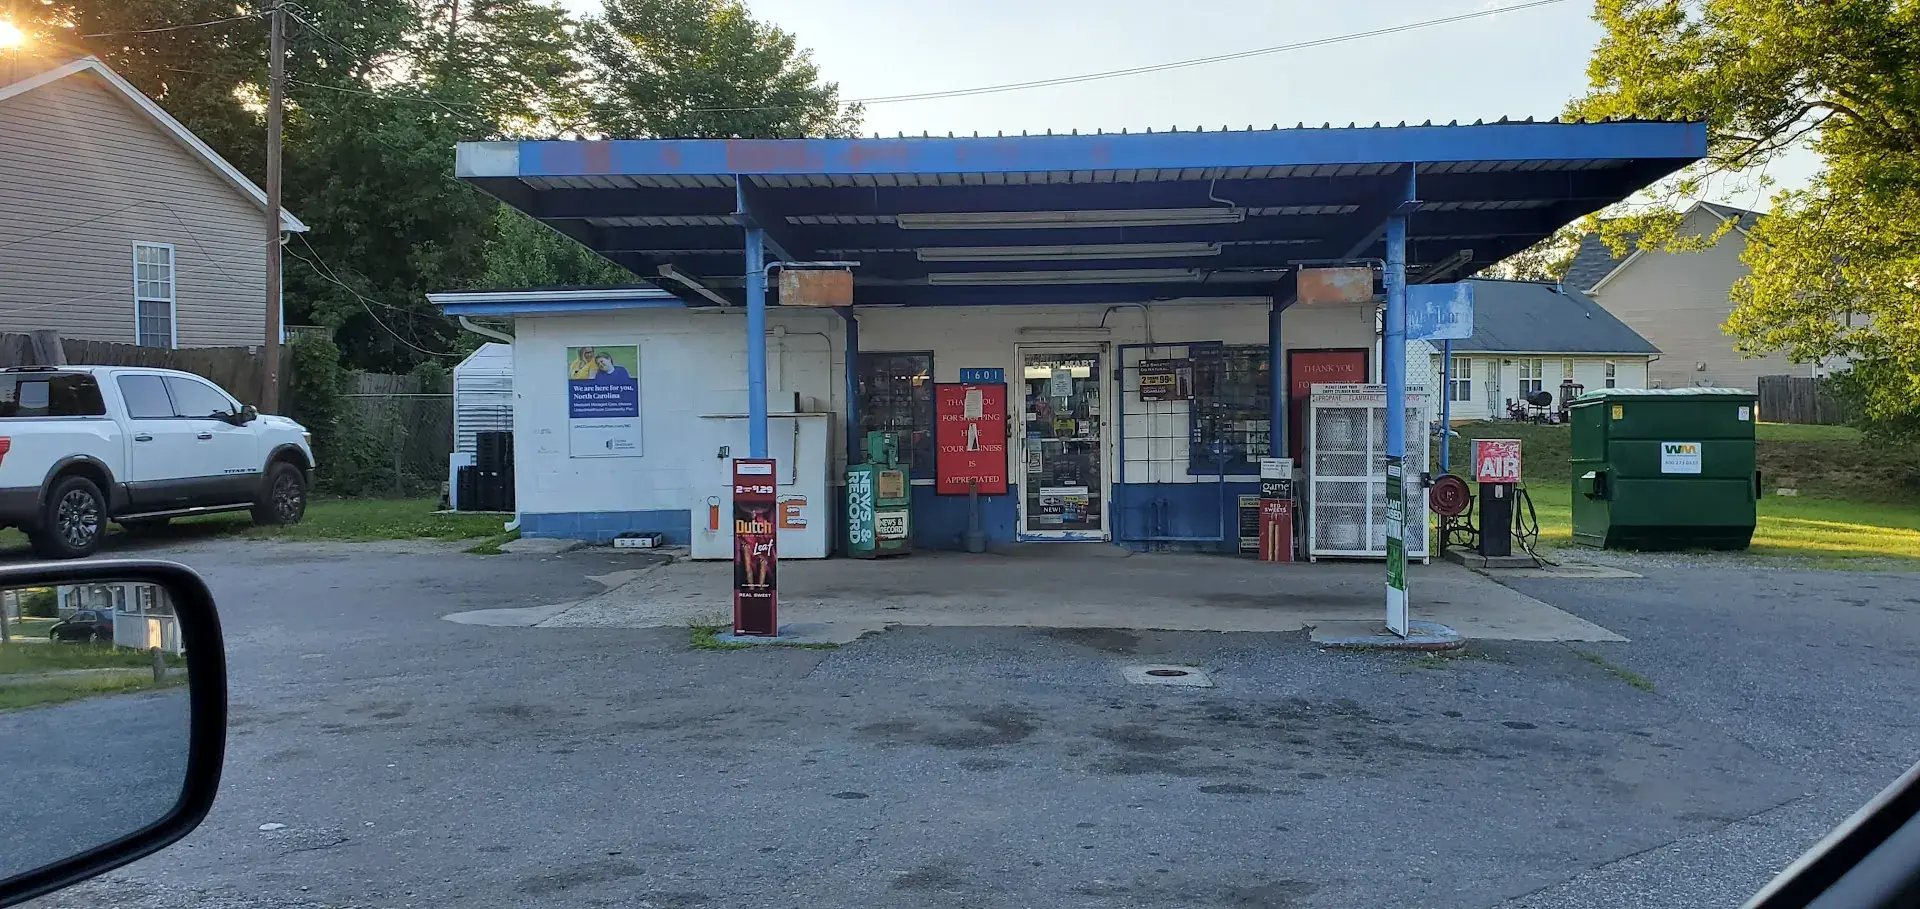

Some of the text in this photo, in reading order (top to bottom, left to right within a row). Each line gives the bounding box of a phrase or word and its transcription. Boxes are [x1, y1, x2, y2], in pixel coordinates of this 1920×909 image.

[1065, 360, 1095, 368] MART
[1304, 363, 1354, 372] THANK YOU
[966, 370, 998, 380] 1601
[1141, 376, 1147, 384] 2
[1298, 381, 1310, 389] FO
[942, 413, 1000, 422] FOR SPING
[961, 429, 983, 437] HE
[942, 444, 1002, 453] YOUR INESS
[1665, 444, 1697, 454] WM
[1480, 457, 1519, 477] AIR
[735, 485, 743, 494] 2
[1262, 482, 1290, 495] game
[848, 471, 861, 544] RECORD
[860, 470, 872, 543] NEWS &
[735, 520, 772, 534] Dutch
[879, 518, 896, 527] NEWS
[880, 526, 903, 534] RECORD
[753, 539, 774, 557] Leaf
